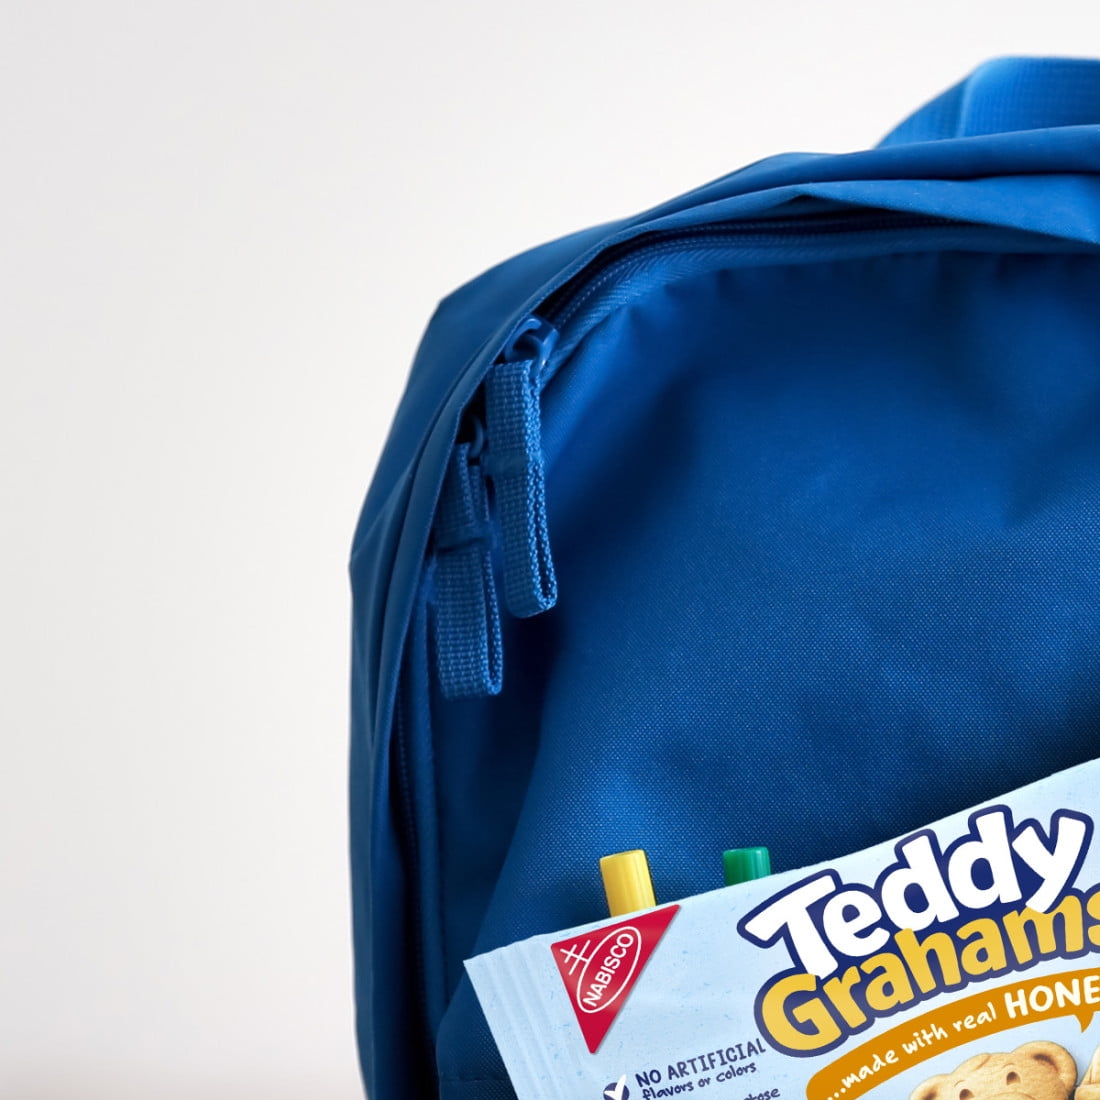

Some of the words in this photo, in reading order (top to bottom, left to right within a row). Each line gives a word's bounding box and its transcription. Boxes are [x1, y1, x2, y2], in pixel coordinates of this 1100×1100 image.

[745, 811, 1087, 978] Teddy
[583, 934, 633, 1007] NABISCO
[902, 1028, 949, 1055] with
[952, 1002, 997, 1032] real
[635, 1069, 662, 1088] NO
[667, 1038, 766, 1081] ARTIFICIAL
[642, 1083, 694, 1100] flavors
[698, 1075, 711, 1088] or
[716, 1061, 757, 1082] colors
